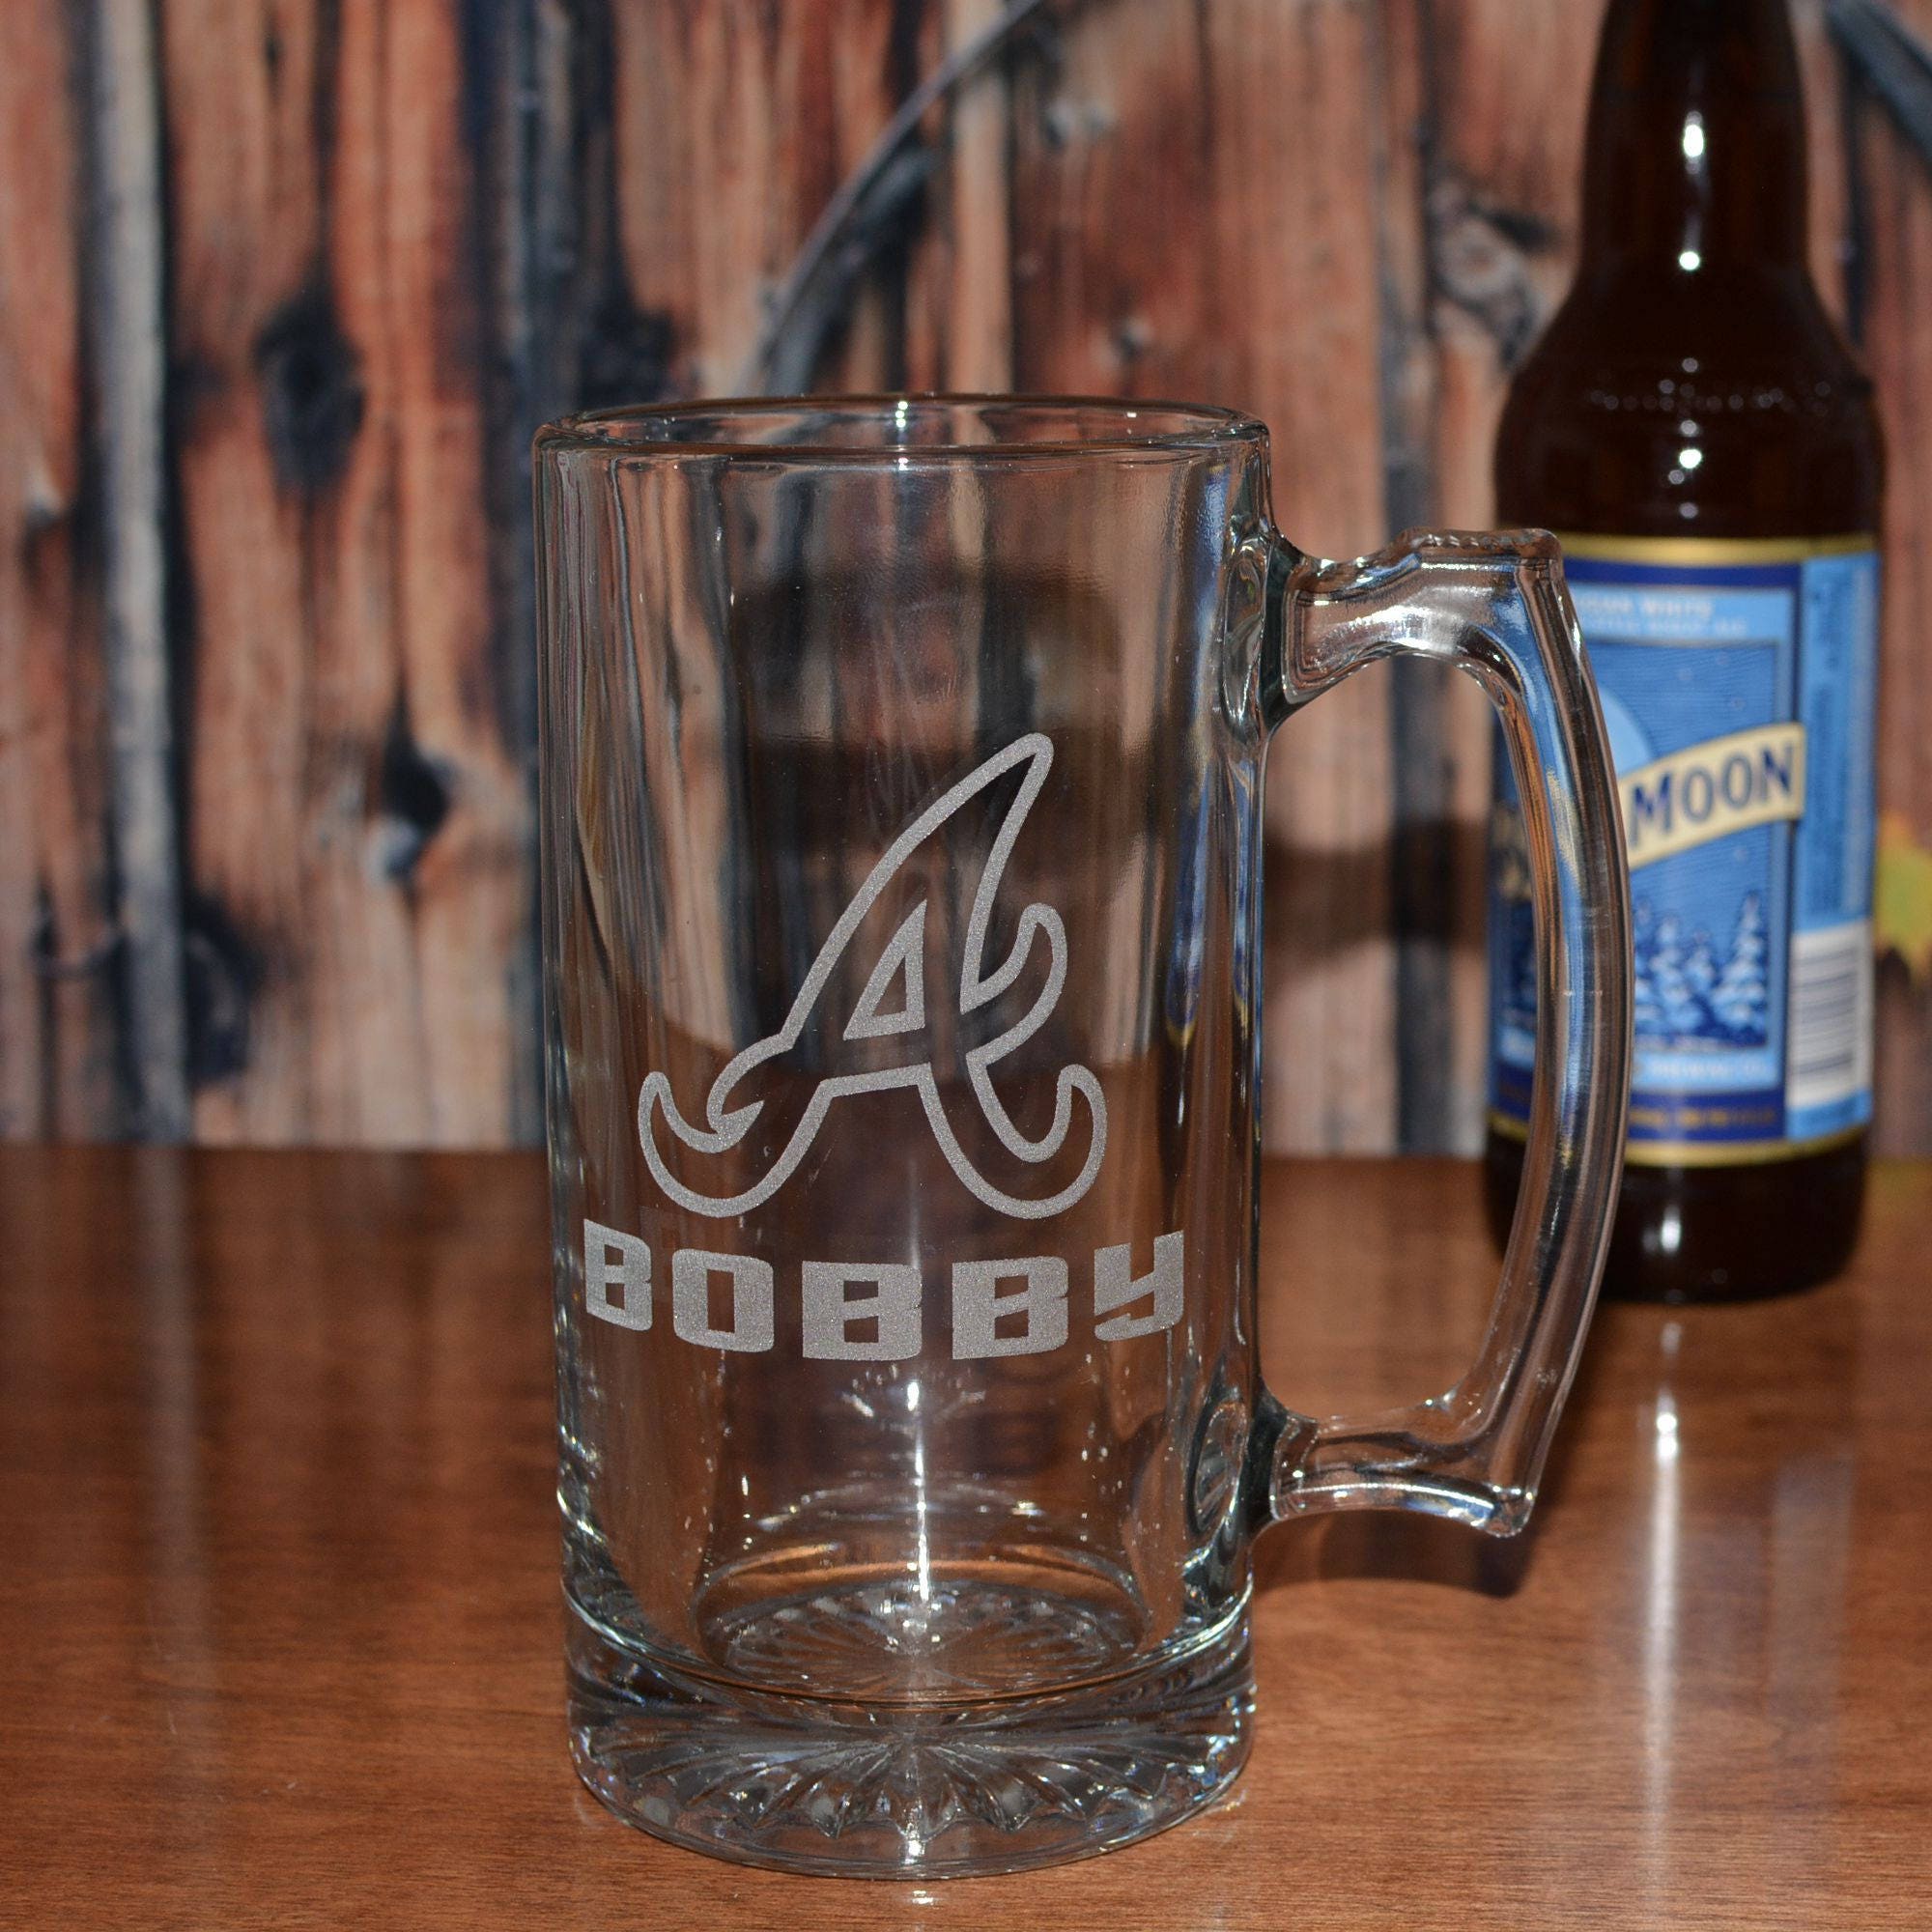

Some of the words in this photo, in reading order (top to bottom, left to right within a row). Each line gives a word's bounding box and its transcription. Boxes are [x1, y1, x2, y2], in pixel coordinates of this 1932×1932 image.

[1628, 741, 1795, 851] MOON
[639, 732, 1107, 1219] A
[583, 1218, 1184, 1361] BOBBY
